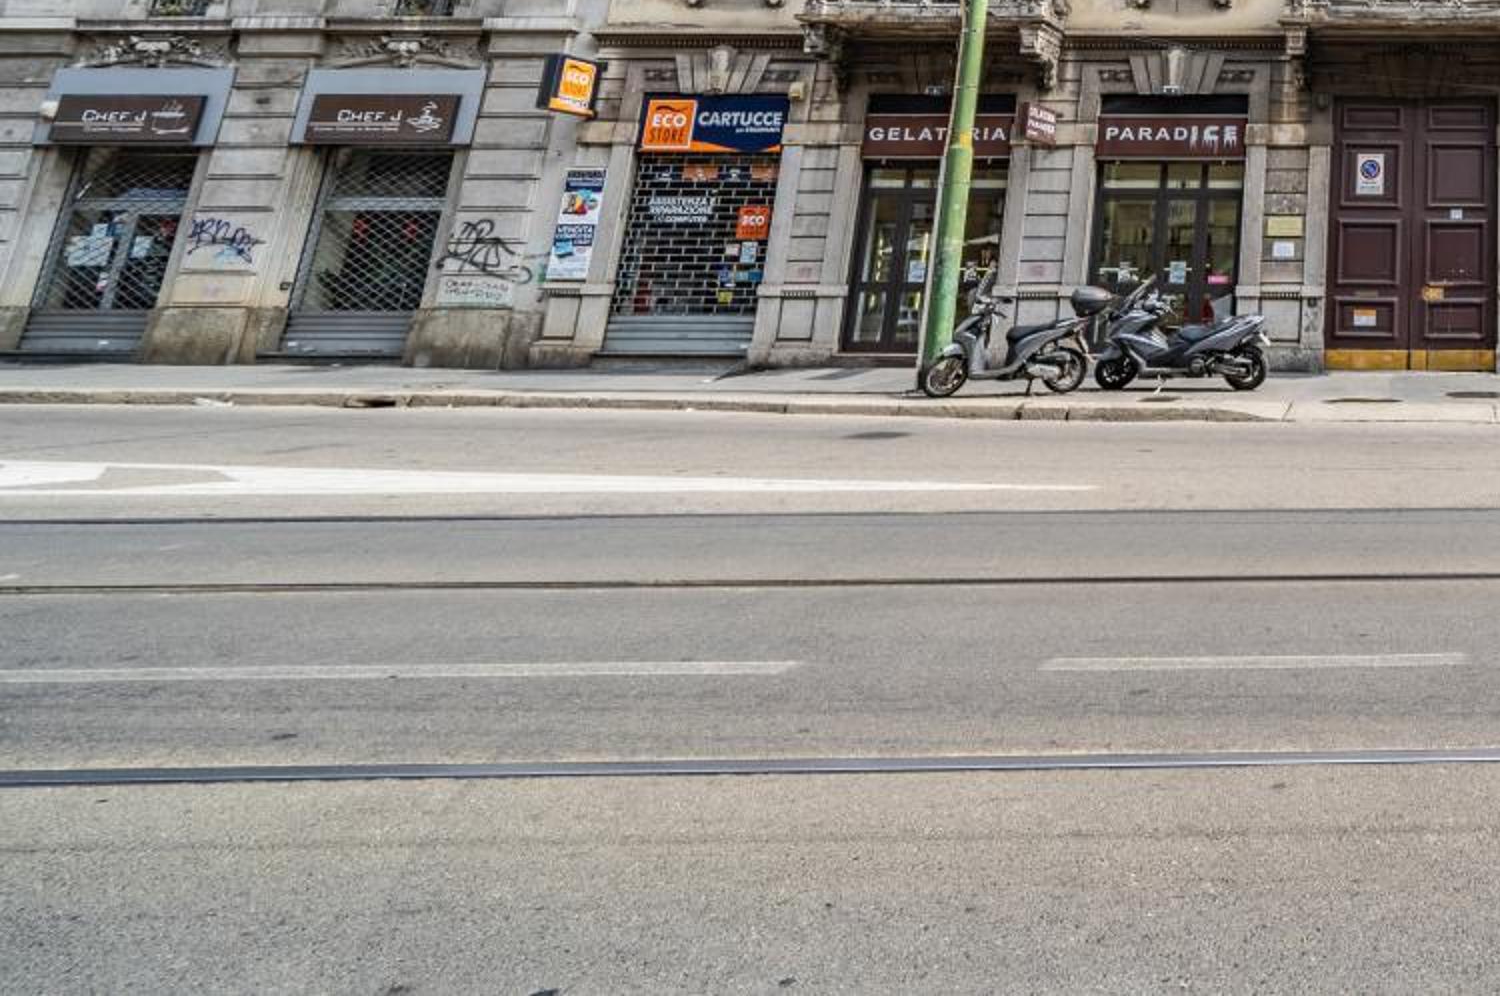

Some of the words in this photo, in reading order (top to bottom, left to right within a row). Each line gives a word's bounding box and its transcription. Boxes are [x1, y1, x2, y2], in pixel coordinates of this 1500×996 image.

[652, 112, 687, 128] ECO
[698, 111, 783, 126] CARTUCCE
[649, 128, 685, 143] STORE
[869, 127, 1007, 141] GELATRIA
[1105, 125, 1238, 146] PARADICE
[741, 215, 765, 226] ECO
